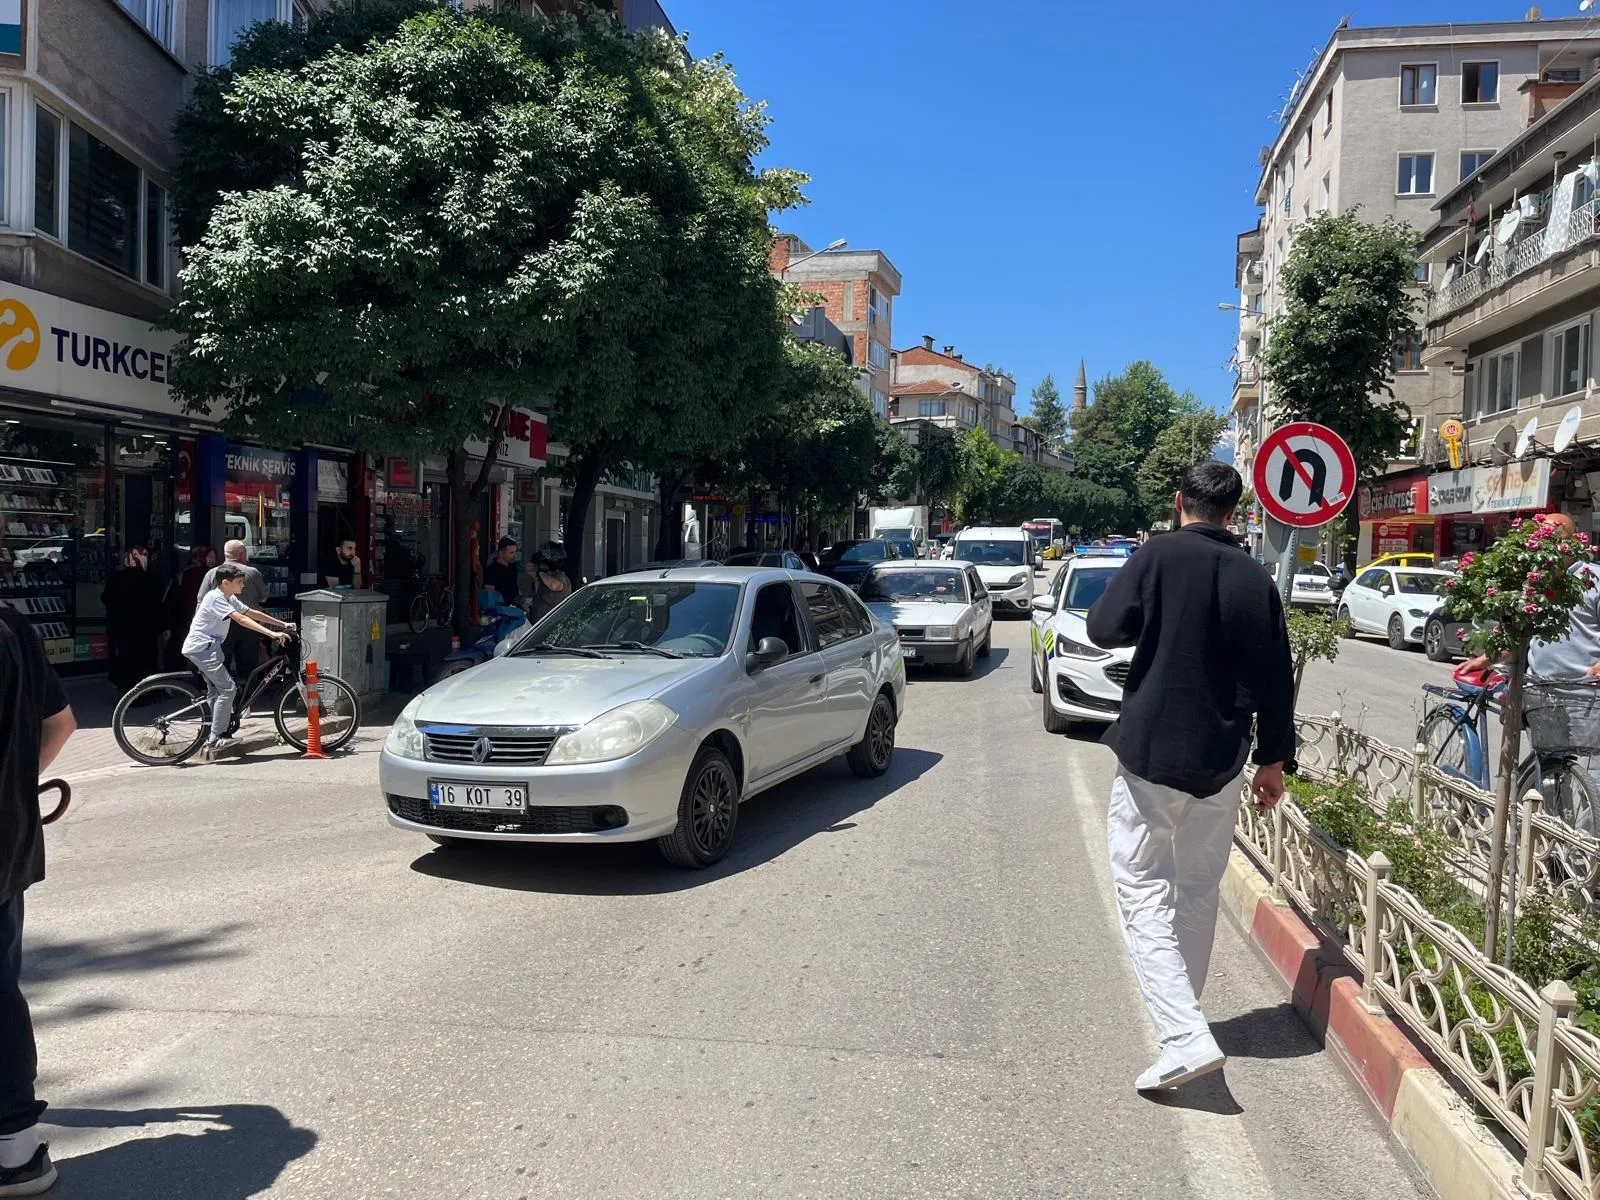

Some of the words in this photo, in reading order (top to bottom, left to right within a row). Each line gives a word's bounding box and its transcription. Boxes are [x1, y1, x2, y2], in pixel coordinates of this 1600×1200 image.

[51, 326, 173, 385] TURKCEL
[440, 785, 455, 804] 16
[466, 787, 491, 806] KOT
[504, 789, 522, 807] 39
